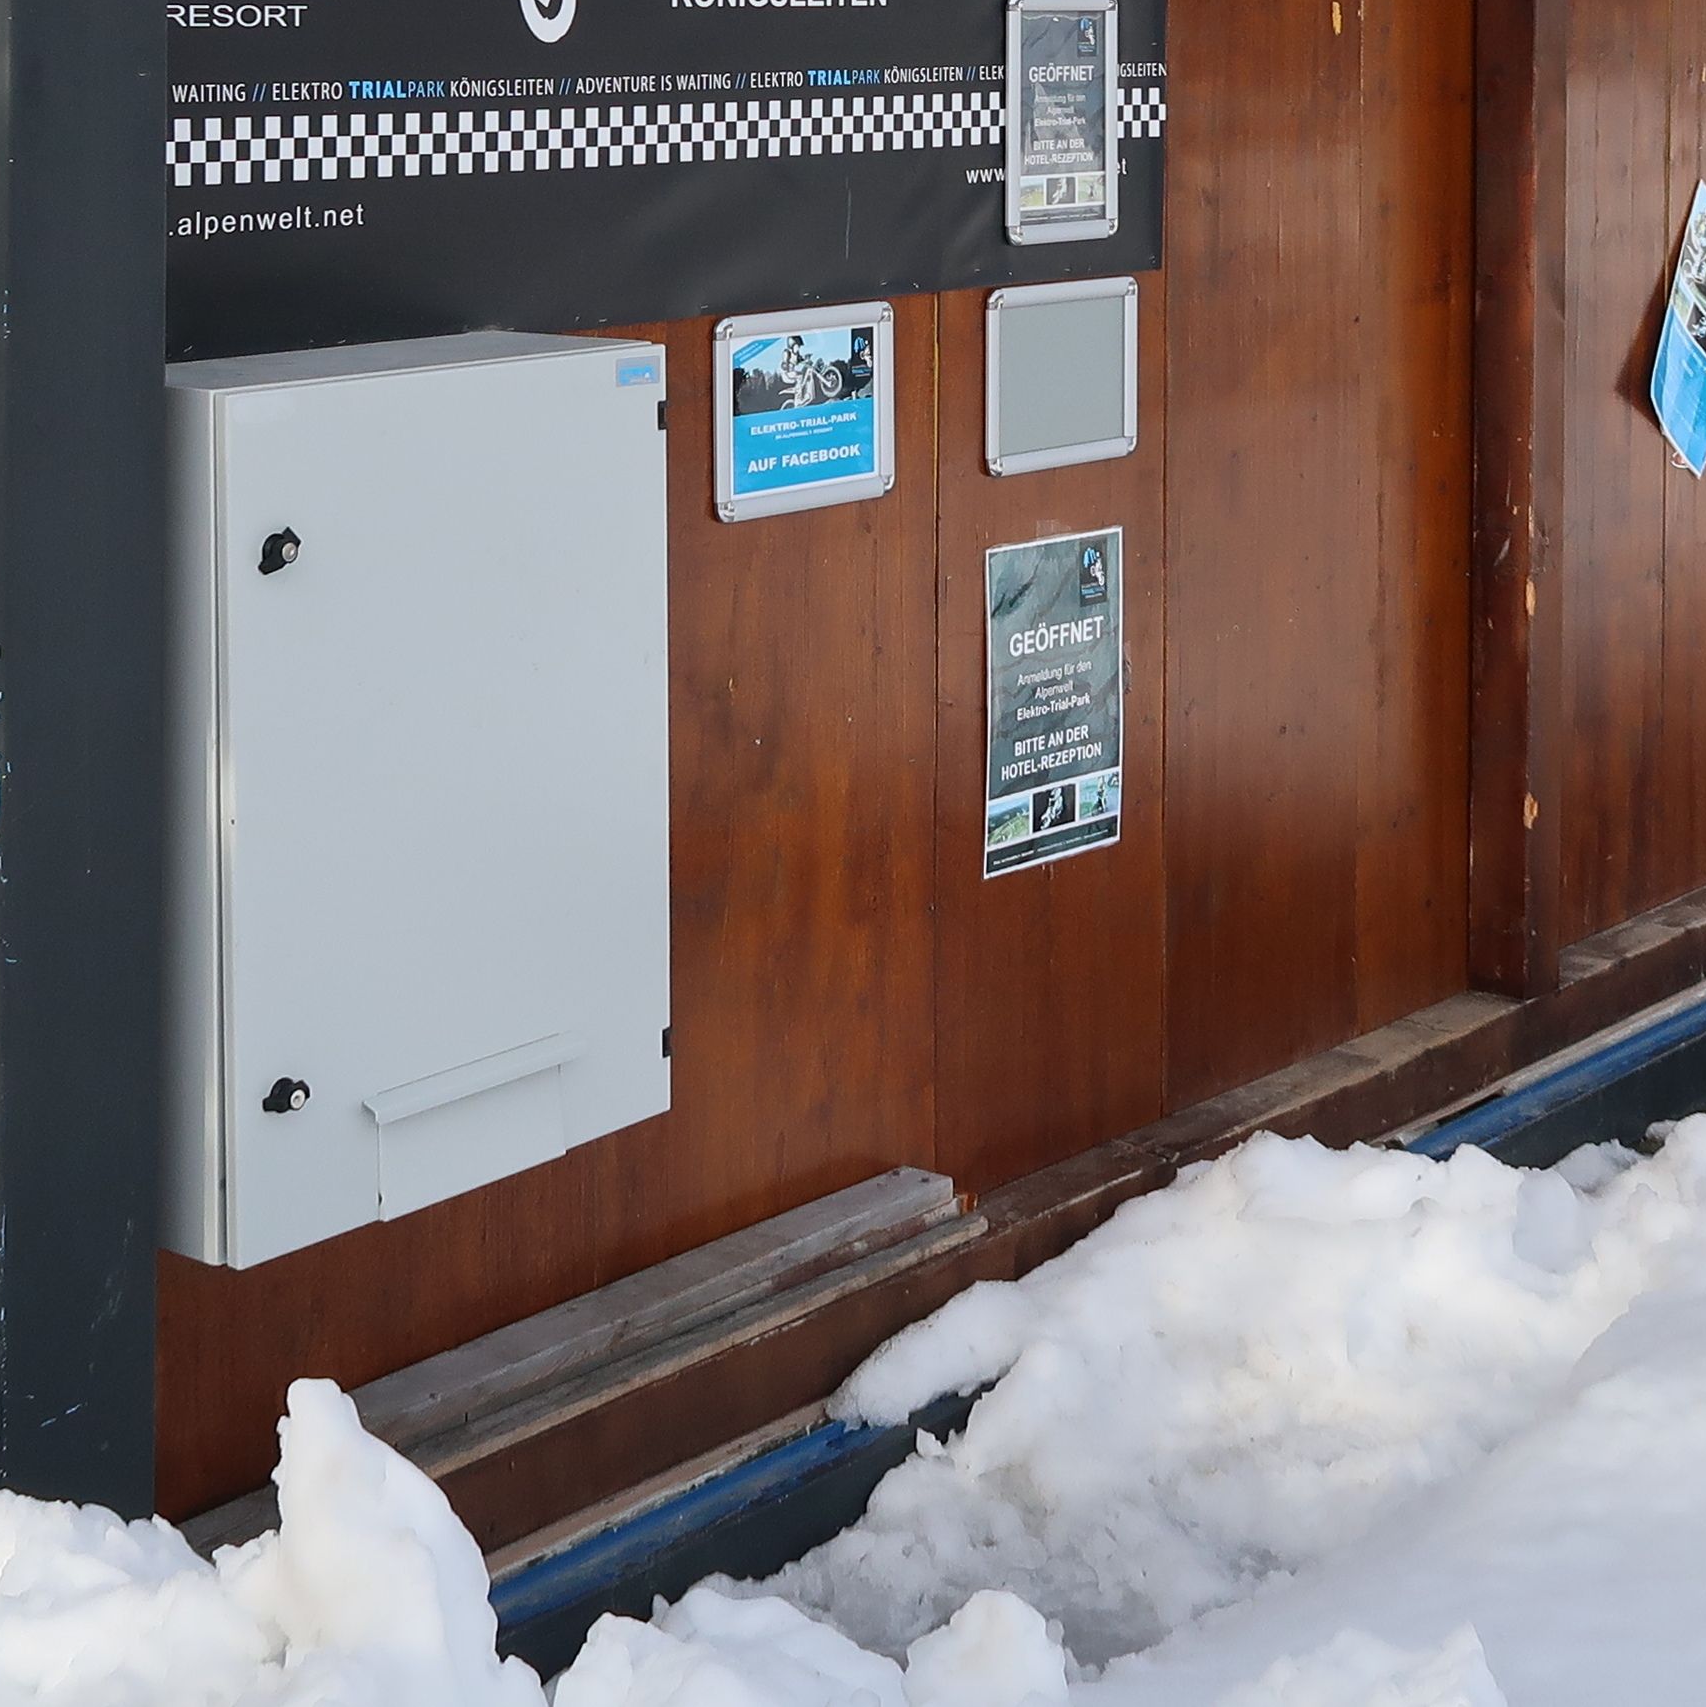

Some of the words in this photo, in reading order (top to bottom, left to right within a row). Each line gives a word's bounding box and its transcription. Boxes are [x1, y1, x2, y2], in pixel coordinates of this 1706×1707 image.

[166, 4, 308, 28] RESORT
[172, 83, 246, 103] WAITING
[272, 81, 343, 102] ELEKTRO
[349, 80, 445, 100] TRIALPARK
[450, 77, 554, 98] KÖNIGSLEITEN
[575, 74, 656, 95] ADVENTURE
[661, 74, 672, 91] IS
[676, 72, 732, 91] WAITING
[750, 71, 803, 90] ELEKTRO
[807, 68, 881, 87] TRIALPARK
[883, 65, 963, 85] KÖNIGSLEITEN
[979, 65, 1004, 81] ELEK
[1028, 63, 1094, 83] GEÖFFNET
[1056, 139, 1068, 149] AN
[1069, 138, 1084, 149] DER
[966, 168, 1005, 184] www
[168, 203, 365, 240] .alpenwelt.net
[750, 412, 857, 436] ELEKTRO-TRIAL-PARK
[748, 457, 777, 474] AUF
[782, 443, 861, 468] FACEBOOK
[1009, 616, 1104, 657] GEÖFFNET
[1017, 693, 1090, 721] Elektro-Trial-Park
[1014, 735, 1045, 757] BITTE
[1048, 730, 1063, 746] AN
[1066, 724, 1089, 742] DER
[1001, 741, 1102, 781] HOTEL-REZEPTION
